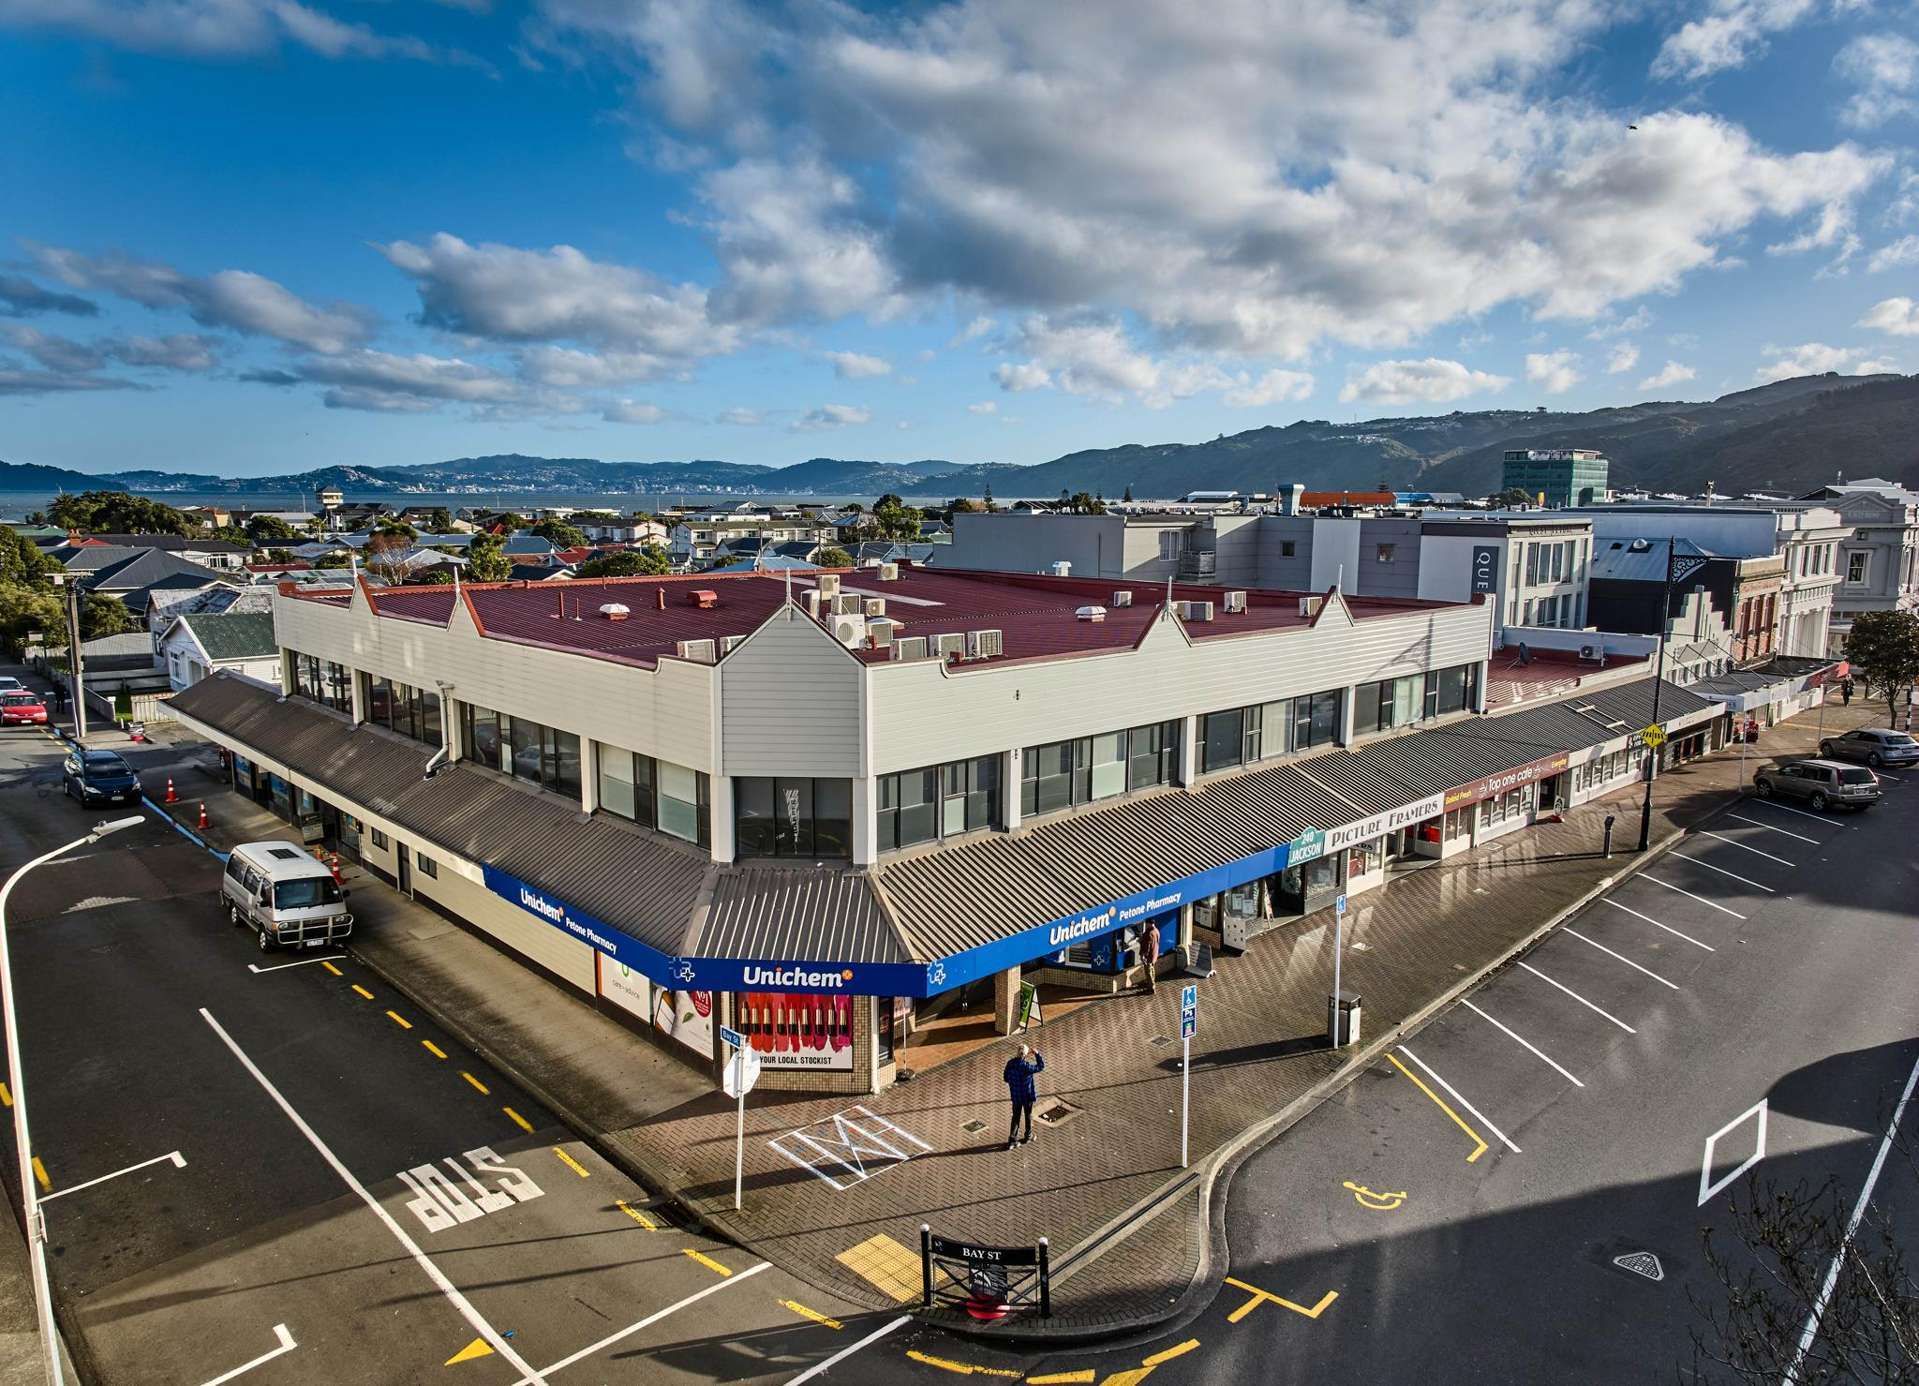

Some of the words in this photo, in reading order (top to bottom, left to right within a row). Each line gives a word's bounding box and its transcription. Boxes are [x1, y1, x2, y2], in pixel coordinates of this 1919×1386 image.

[1488, 778, 1501, 792] Top
[1502, 773, 1516, 787] one
[1517, 766, 1533, 781] cafe
[1331, 818, 1382, 847] PICTURE
[1389, 800, 1438, 827] FRAMERS
[1291, 843, 1321, 863] JACKSON
[521, 888, 561, 922] Unichem
[566, 917, 586, 936] Petone
[587, 928, 617, 955] Pharmacy
[1050, 913, 1110, 945] Unichem
[1119, 905, 1145, 921] Petone
[1146, 892, 1182, 911] Pharmacy
[743, 966, 843, 988] Unichem
[759, 1055, 777, 1065] YOUR
[778, 1056, 798, 1065] LOCAL
[800, 1056, 832, 1065] STOCKIST
[396, 1145, 545, 1233] STOP
[962, 1247, 985, 1260] BAY
[987, 1251, 1002, 1261] ST
